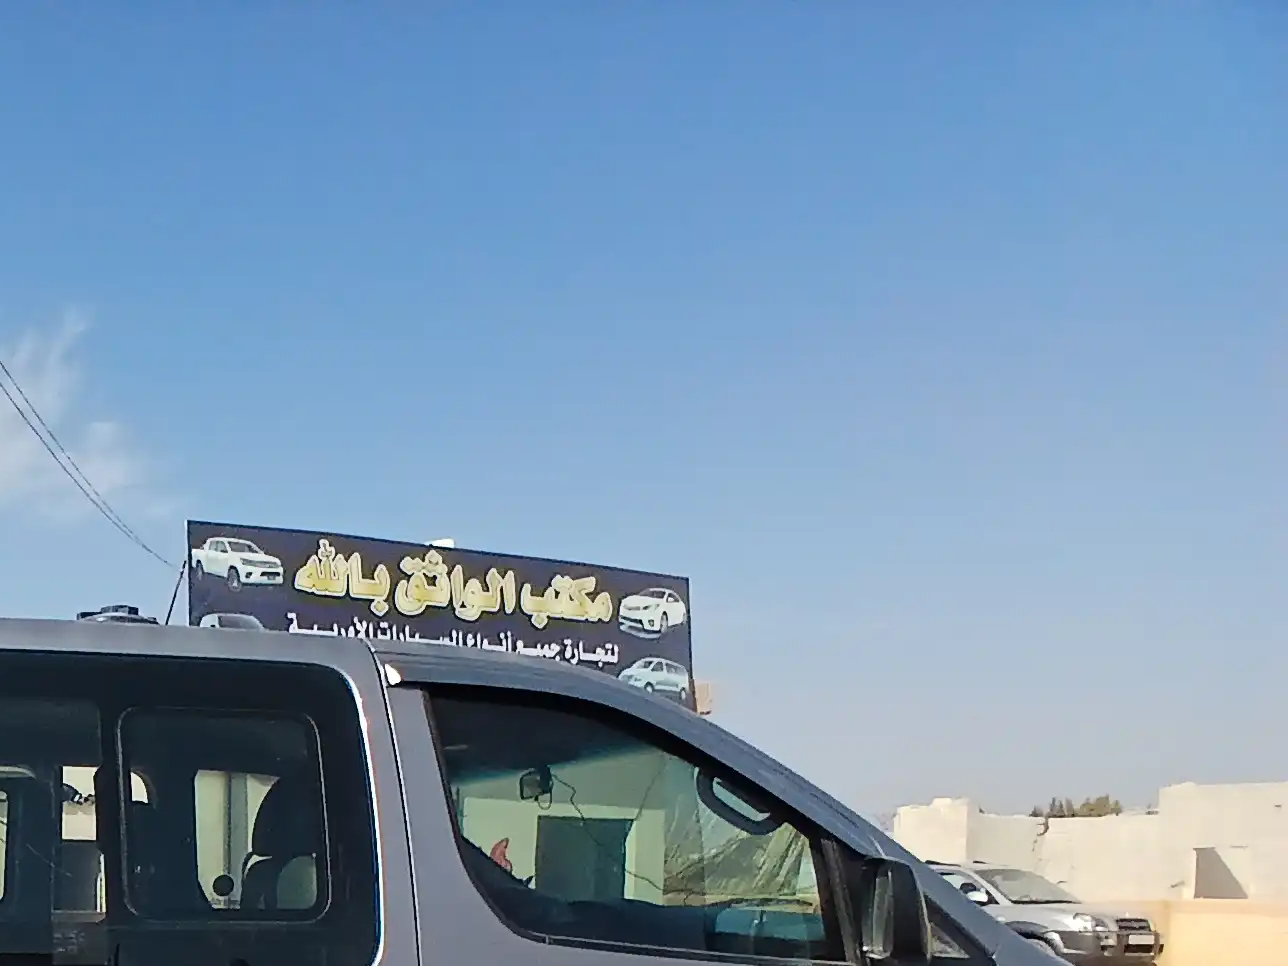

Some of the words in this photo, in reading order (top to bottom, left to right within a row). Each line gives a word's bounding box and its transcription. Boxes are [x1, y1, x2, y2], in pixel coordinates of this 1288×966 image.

[294, 538, 390, 617] بالله
[394, 549, 516, 621] الواثق
[520, 574, 613, 629] مكتب
[563, 638, 619, 668] لتجارة
